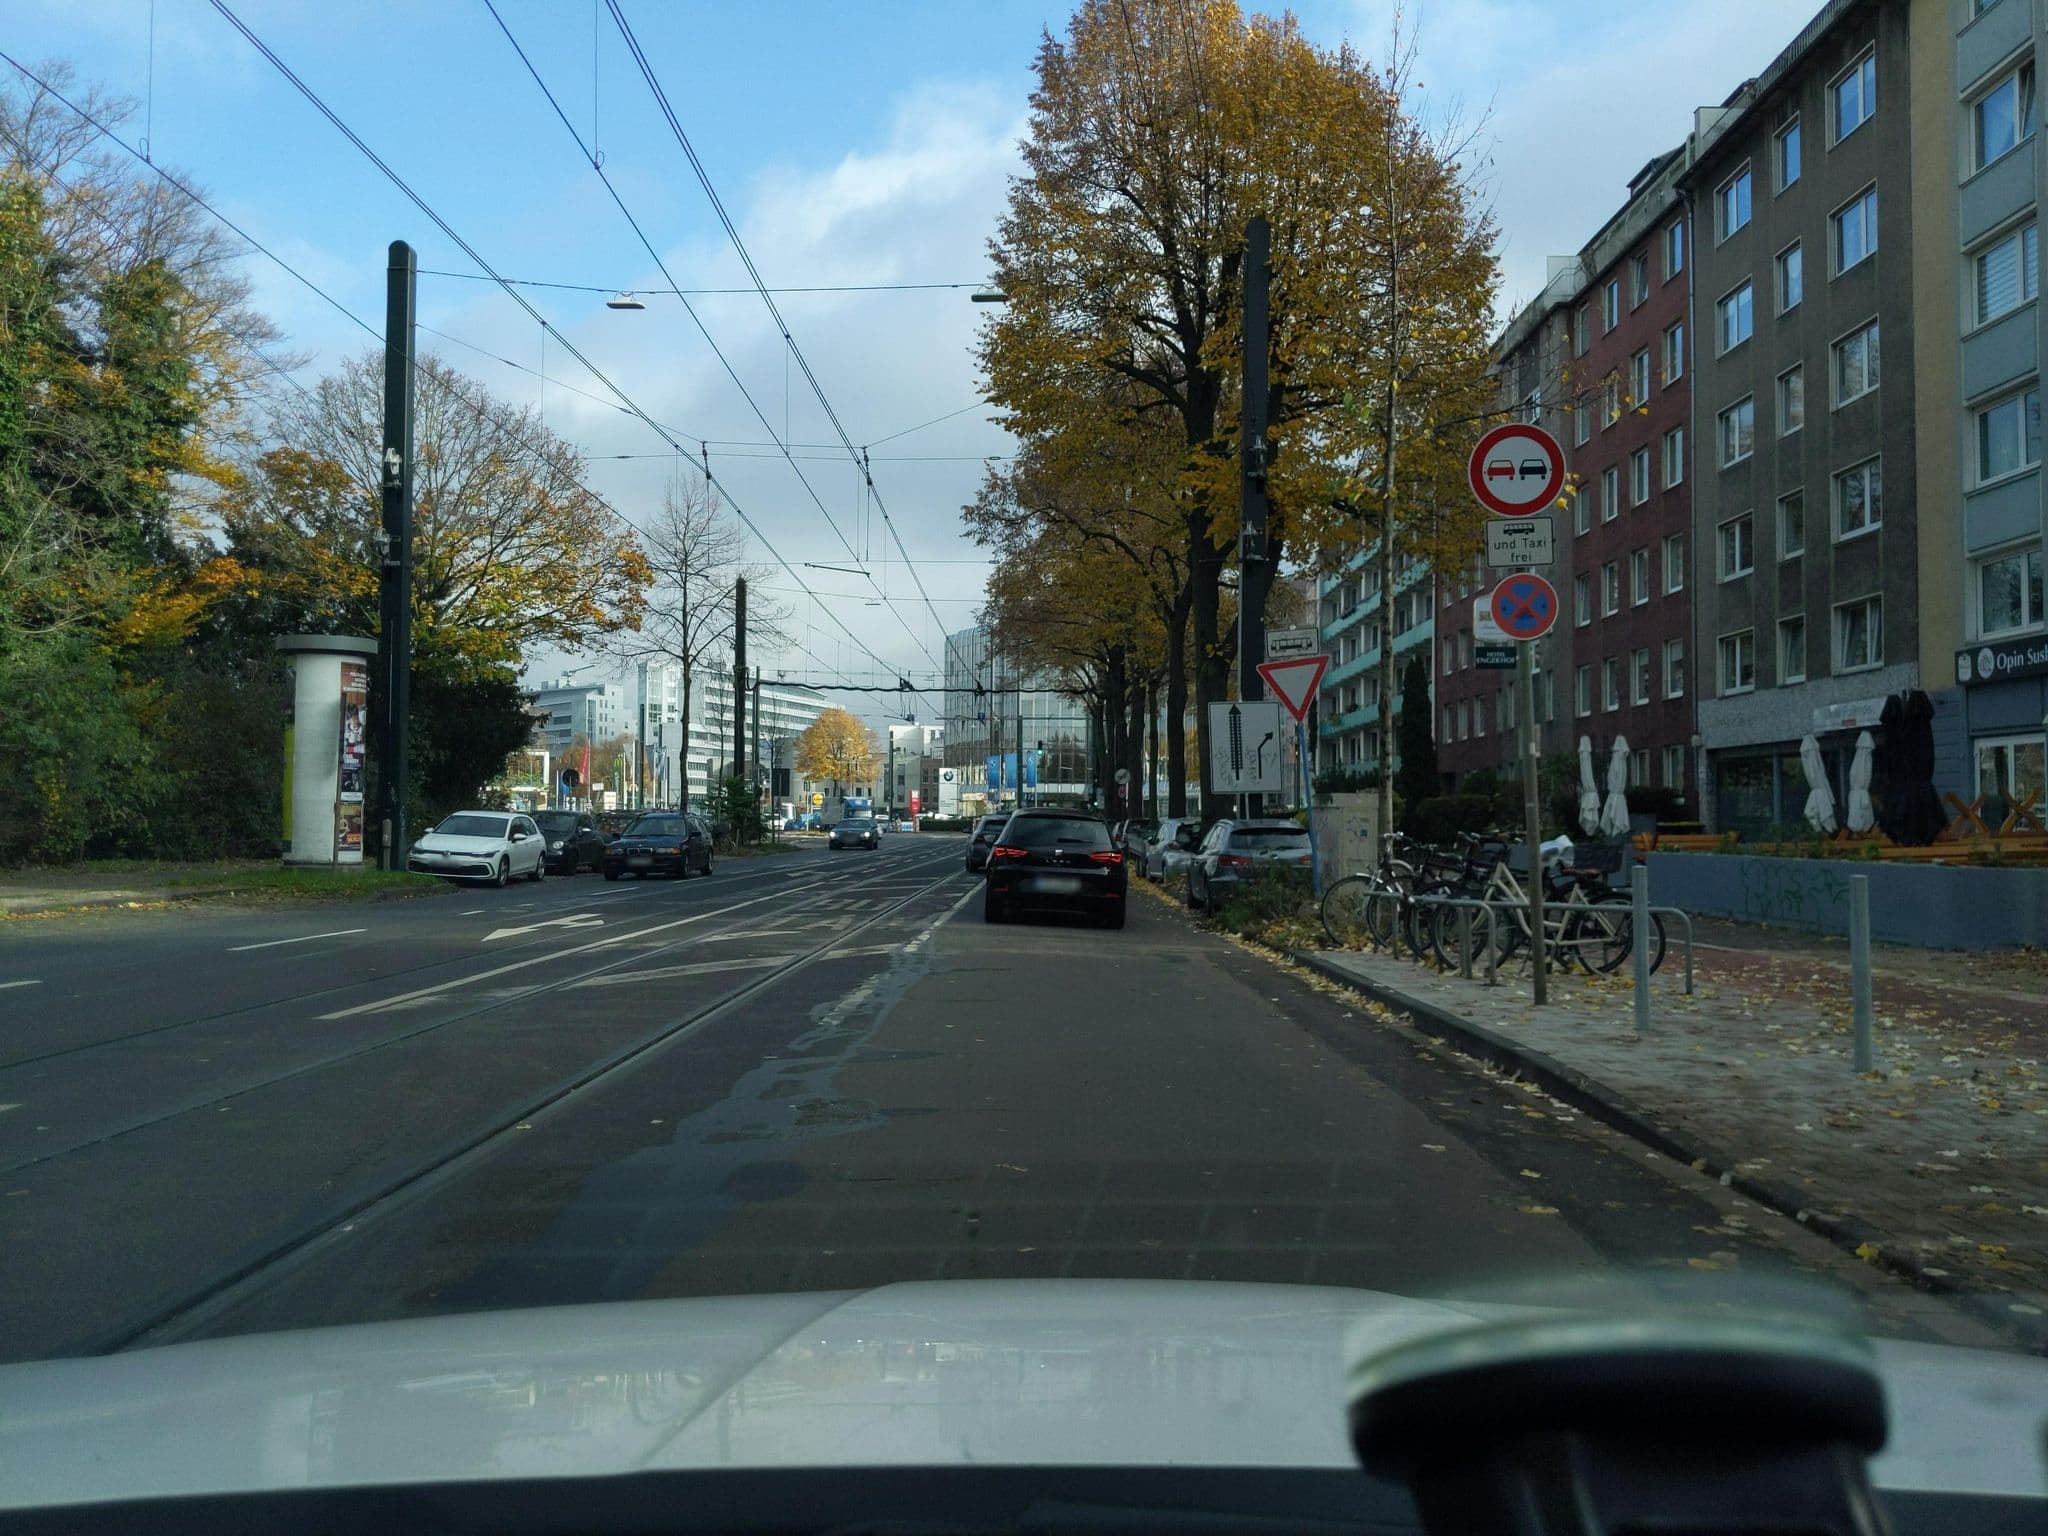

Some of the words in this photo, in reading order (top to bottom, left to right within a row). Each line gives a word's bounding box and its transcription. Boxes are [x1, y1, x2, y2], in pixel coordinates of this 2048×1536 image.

[1494, 539, 1516, 550] und
[1522, 537, 1546, 549] Taxi
[1510, 552, 1532, 563] frei
[1996, 650, 2024, 674] Opin
